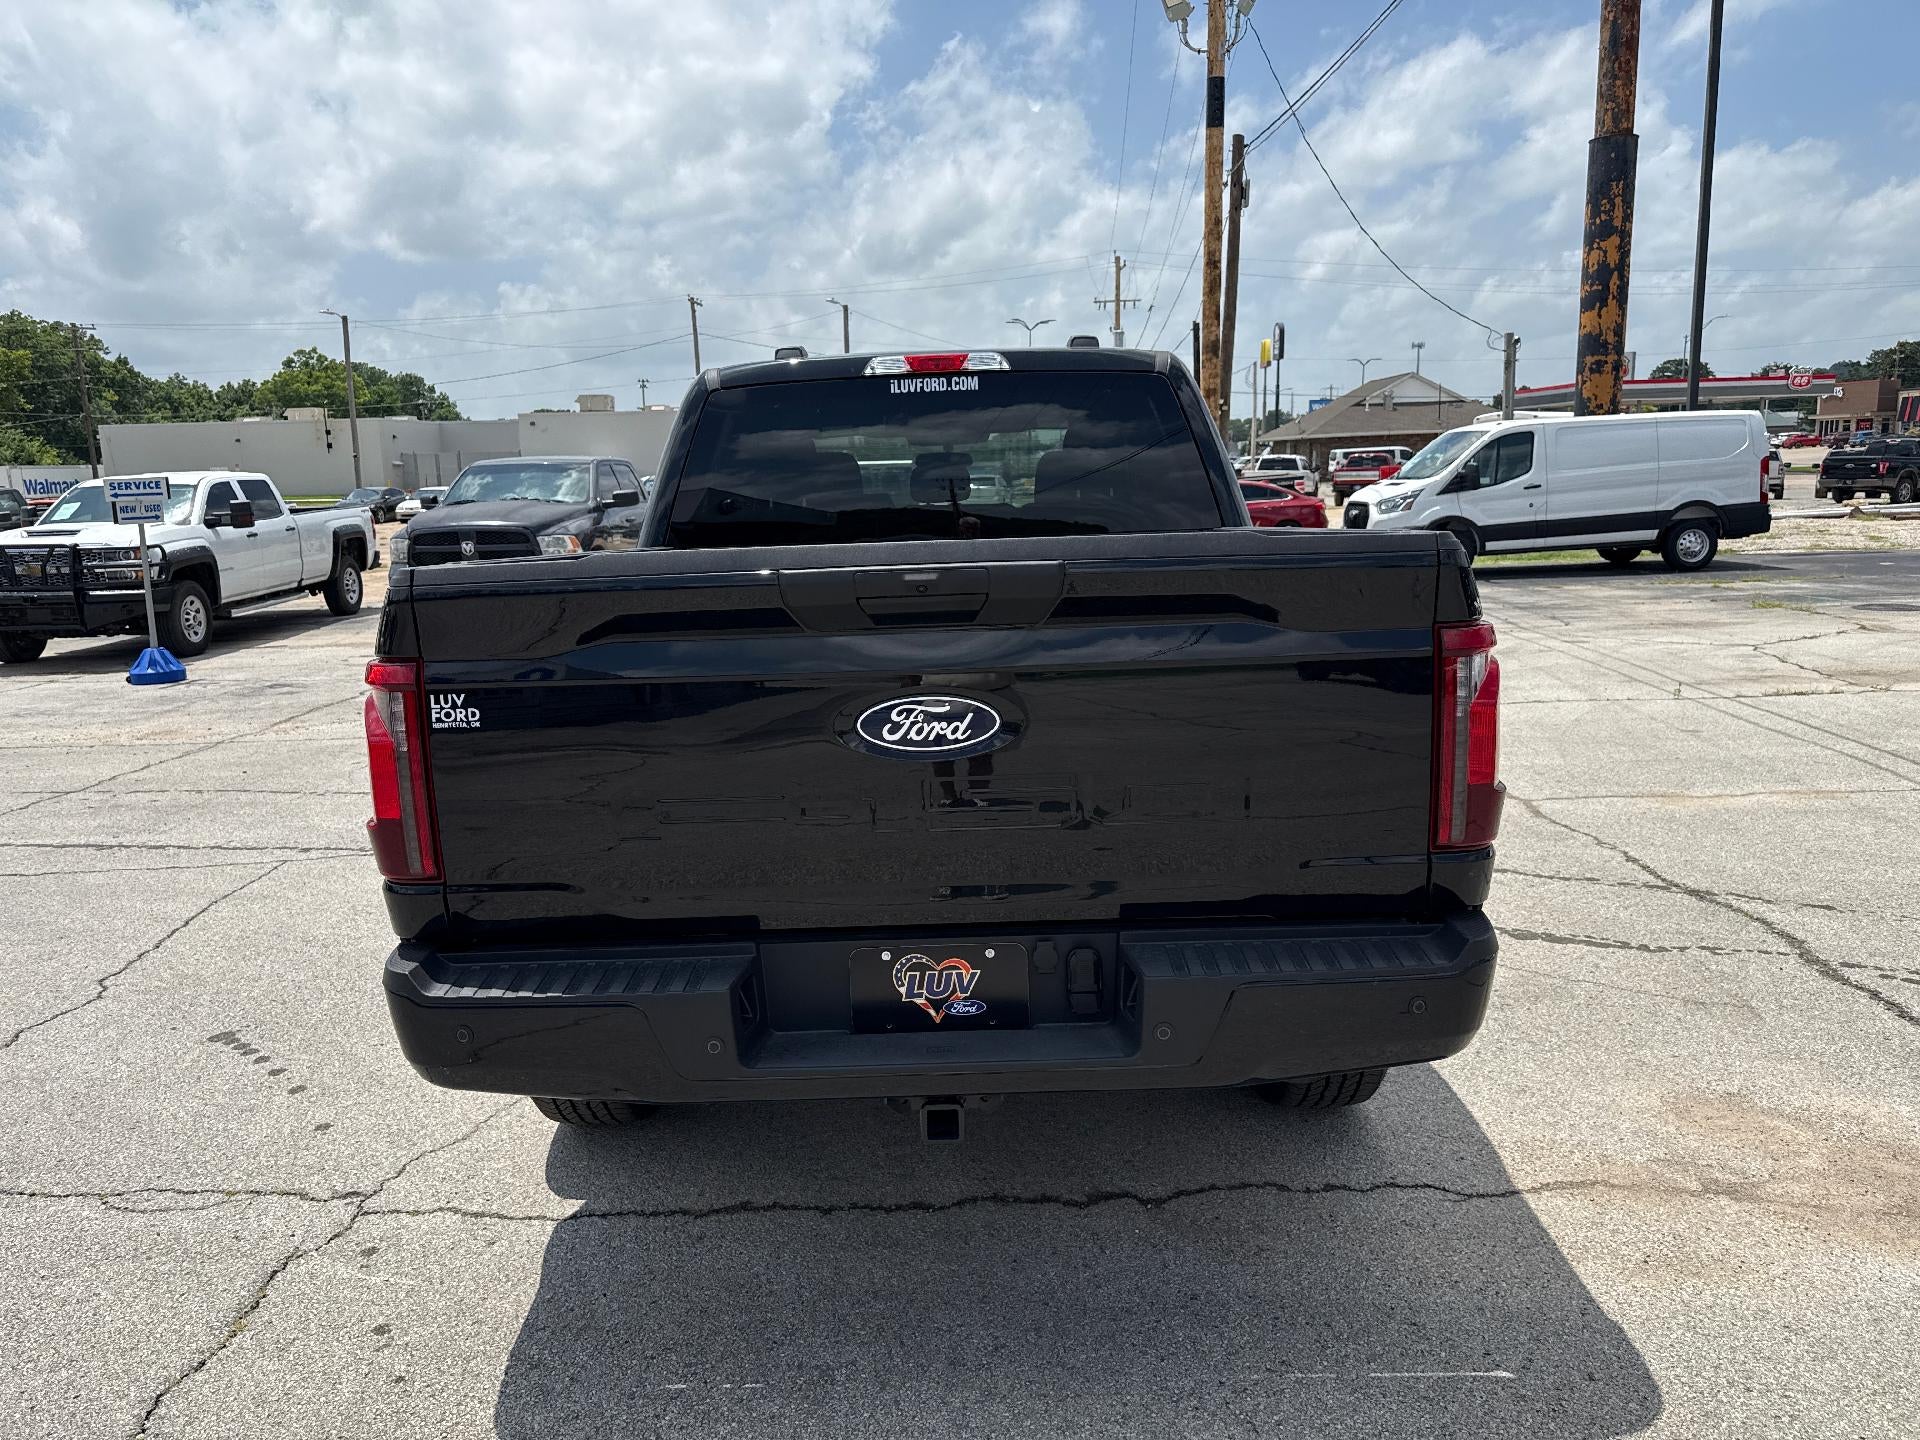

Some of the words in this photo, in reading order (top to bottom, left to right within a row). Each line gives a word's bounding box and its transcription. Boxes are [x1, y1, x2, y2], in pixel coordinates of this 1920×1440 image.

[890, 376, 979, 394] iLUVFORD.COM
[1793, 376, 1809, 386] 66
[108, 480, 162, 491] SERVICE
[119, 505, 137, 514] NEW
[144, 504, 162, 513] USED
[429, 693, 466, 708] LUV
[431, 708, 480, 722] FORD
[882, 703, 974, 741] Ford
[902, 969, 981, 1002] LUV
[951, 1001, 978, 1014] Ford
